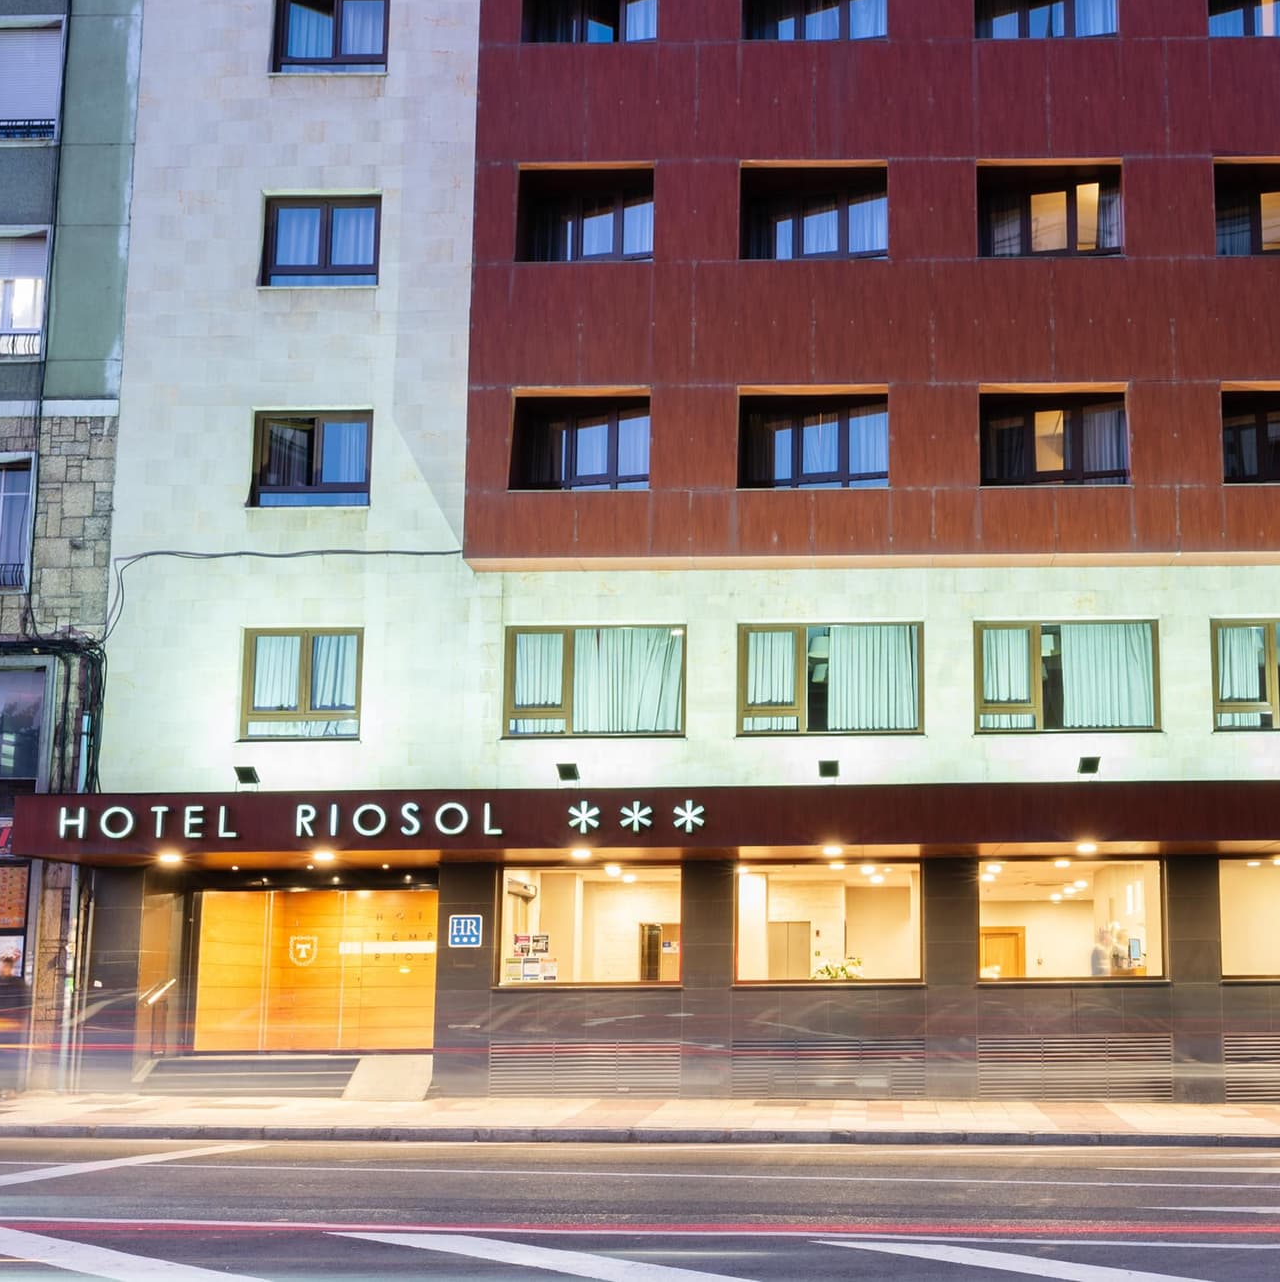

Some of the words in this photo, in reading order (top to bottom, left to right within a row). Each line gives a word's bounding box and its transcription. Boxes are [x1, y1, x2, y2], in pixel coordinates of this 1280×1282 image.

[57, 804, 239, 839] HOTEL
[295, 801, 503, 837] RIOSOL
[451, 919, 480, 936] HR
